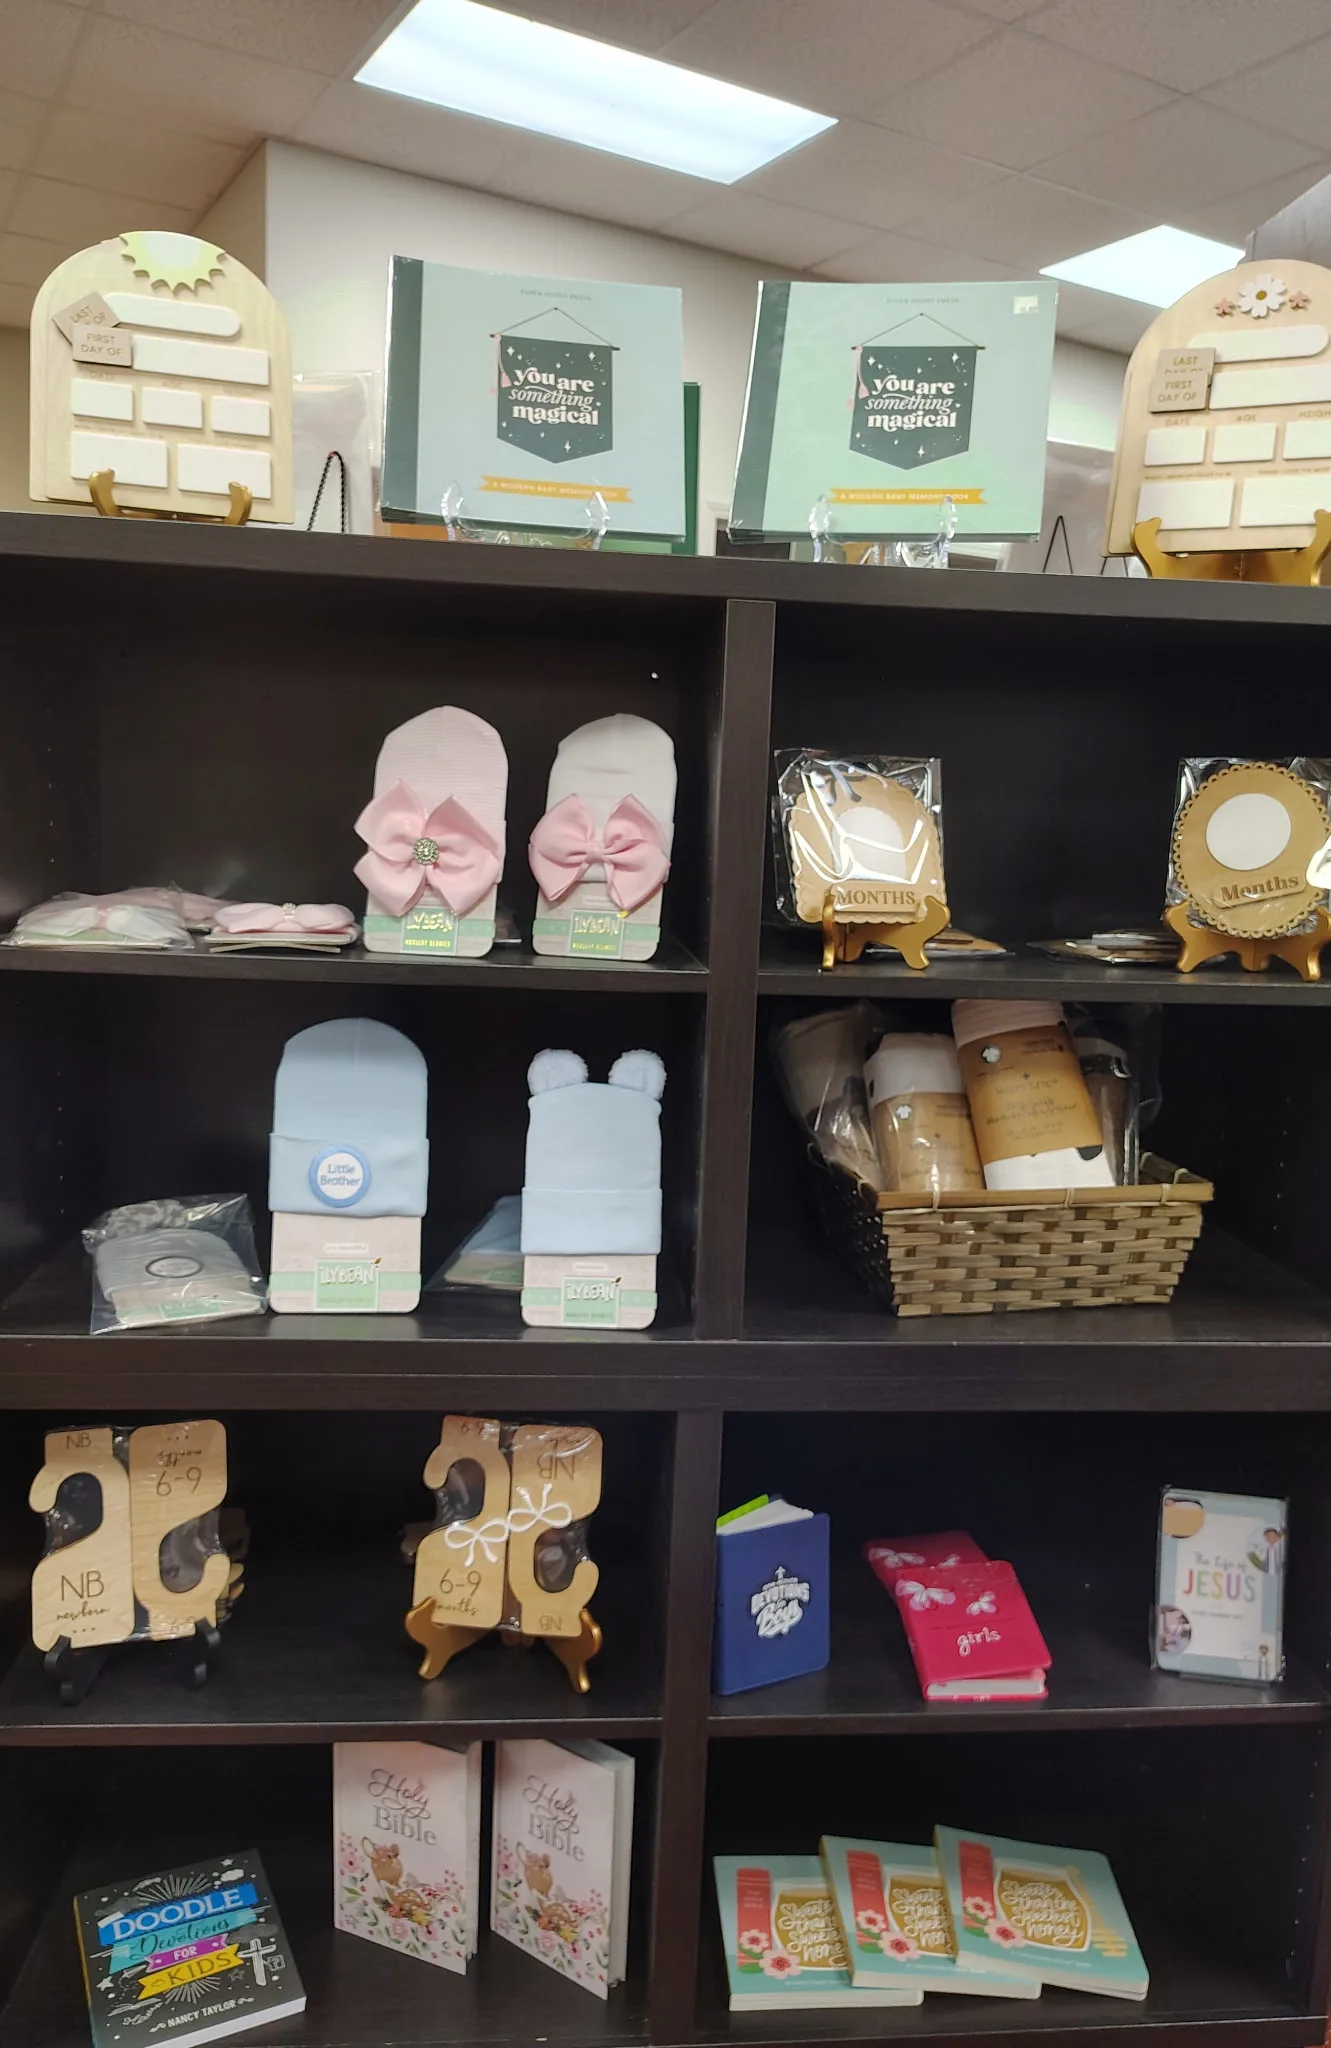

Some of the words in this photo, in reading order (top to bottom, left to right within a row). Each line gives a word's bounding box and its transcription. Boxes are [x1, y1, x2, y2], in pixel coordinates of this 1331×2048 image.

[70, 305, 93, 324] LAST
[87, 333, 115, 345] FIRST
[81, 344, 104, 354] DAY
[107, 347, 122, 356] OF
[1173, 356, 1198, 366] LAST
[513, 367, 555, 386] you
[557, 378, 594, 392] are
[872, 375, 914, 395] you
[916, 382, 955, 395] are
[1165, 380, 1193, 390] FIRST
[508, 386, 594, 412] something
[865, 394, 954, 414] something
[1157, 393, 1179, 403] DAY
[1183, 392, 1198, 401] OF
[512, 405, 598, 425] magical
[867, 411, 957, 432] magical
[1165, 417, 1190, 427] DATE
[1236, 414, 1257, 422] AGE
[1299, 408, 1331, 419] HEIGH
[837, 891, 916, 905] MONTHS
[1221, 876, 1298, 900] Months
[328, 1163, 356, 1174] Little
[320, 1175, 360, 1186] Brother
[66, 1433, 92, 1449] NB
[537, 1453, 576, 1481] NB
[156, 1466, 202, 1497] 6-9
[61, 1570, 105, 1601] NB
[439, 1568, 482, 1597] 6-9
[1183, 1568, 1257, 1604] JESUS
[56, 1601, 111, 1621] newborn
[437, 1598, 480, 1617] months
[538, 1614, 563, 1632] NB
[957, 1626, 1001, 1657] girls
[368, 1768, 432, 1820] Holy
[522, 1774, 580, 1834] Holy
[372, 1804, 437, 1846] Bible
[528, 1810, 585, 1863] Bible
[112, 1888, 244, 1941] DOODLE
[129, 1917, 230, 1962] Devotions
[173, 1946, 198, 1962] FOR
[166, 1951, 233, 1986] KIDS
[167, 2010, 201, 2029] NANCY
[202, 1999, 237, 2018] TAYLOR
